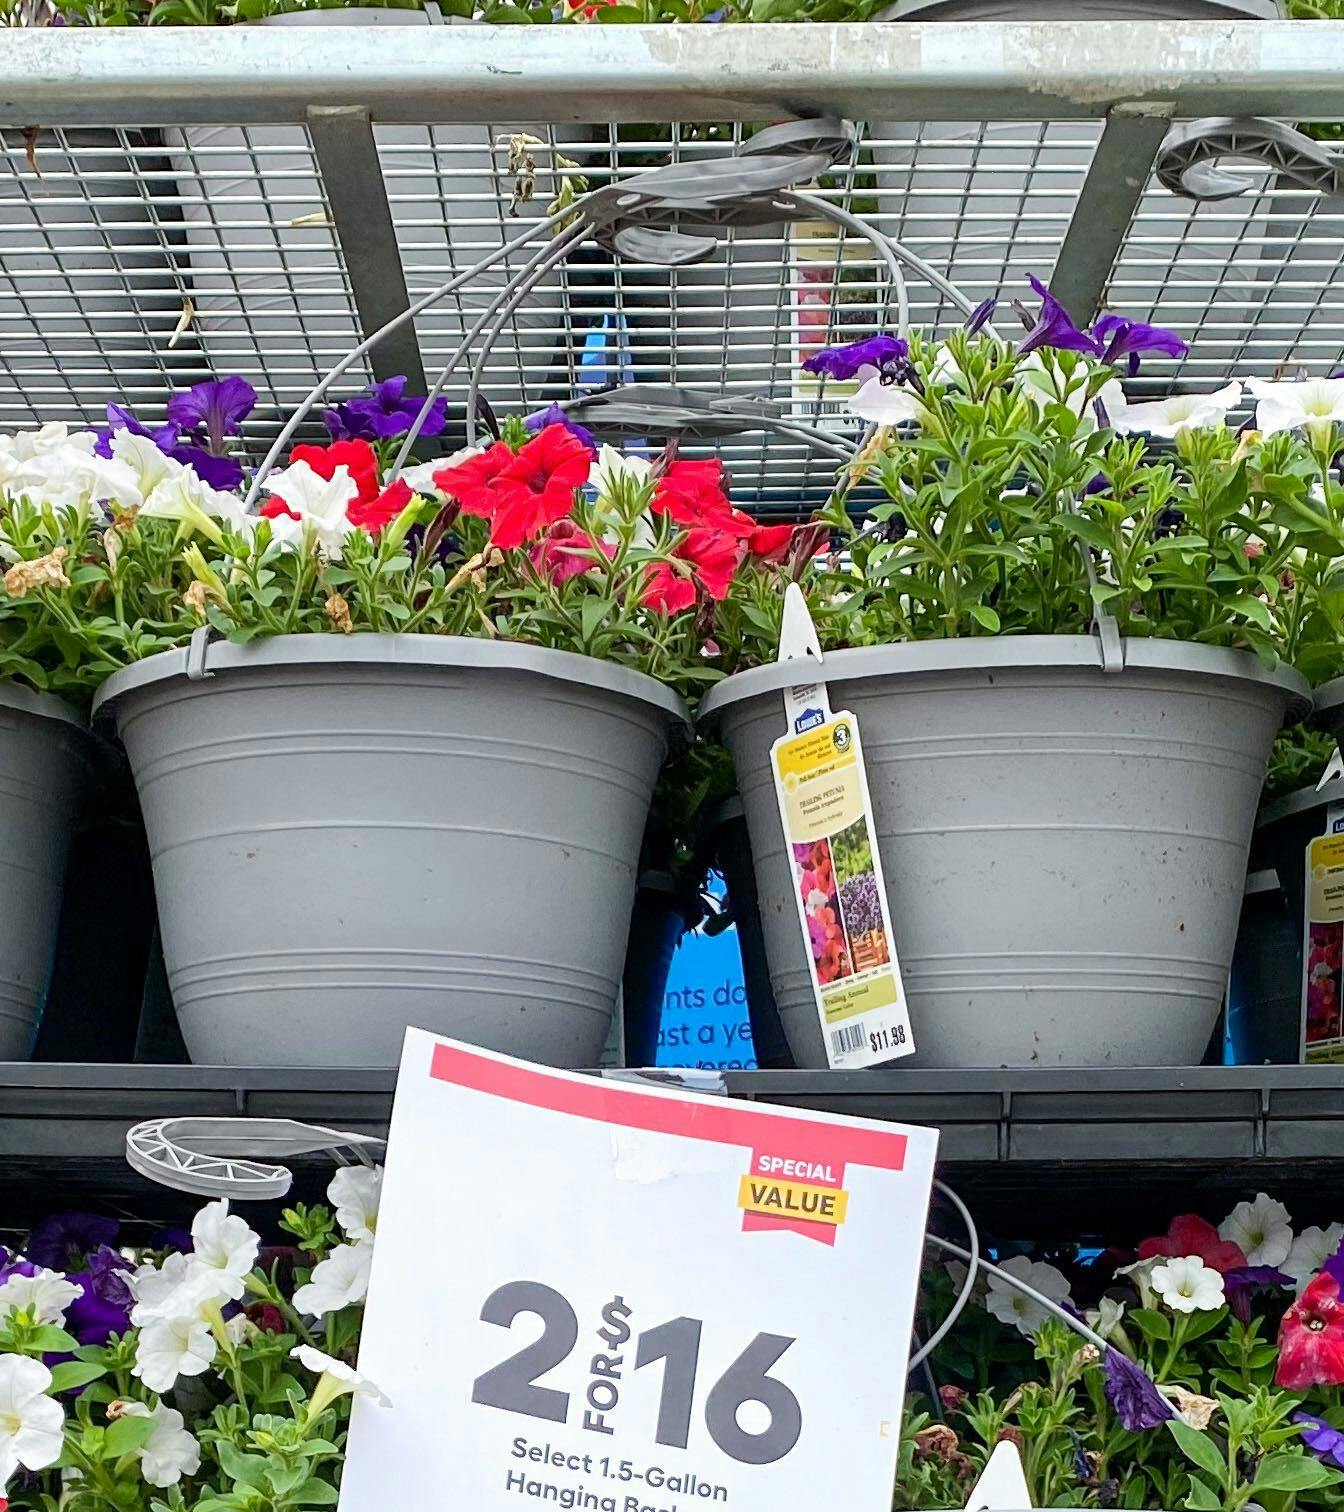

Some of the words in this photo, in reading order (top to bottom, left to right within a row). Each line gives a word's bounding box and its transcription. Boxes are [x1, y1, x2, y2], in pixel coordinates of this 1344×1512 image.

[870, 1025, 906, 1053] $11.98
[759, 1155, 836, 1183] SPECIAL
[750, 1183, 836, 1218] VALUE
[471, 1280, 579, 1424] 2
[582, 1351, 625, 1436] FOR
[510, 1436, 592, 1474] Select
[599, 1455, 729, 1503] 1.5-Gallon
